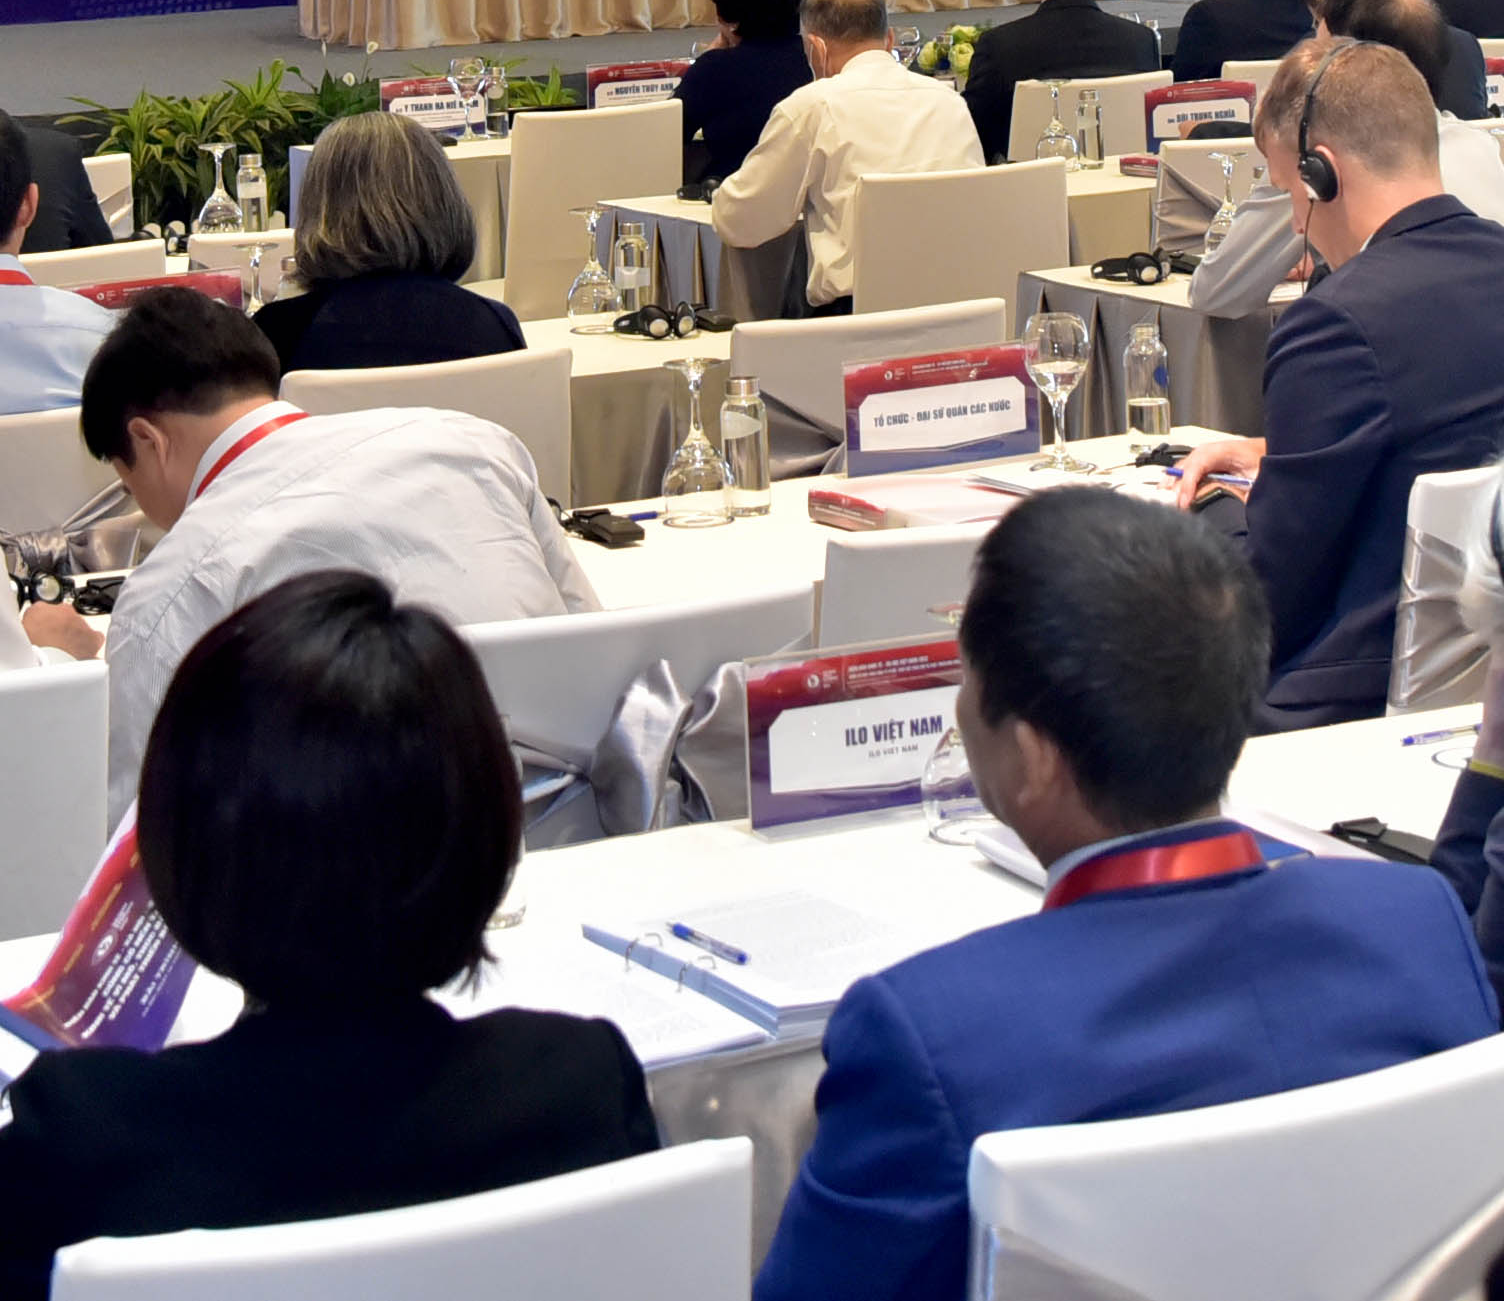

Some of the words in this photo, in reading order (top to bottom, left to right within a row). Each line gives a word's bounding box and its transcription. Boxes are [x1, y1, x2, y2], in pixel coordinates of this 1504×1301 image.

[845, 726, 868, 747] ILO
[872, 719, 905, 742] VIỆT
[910, 715, 943, 737] NAM
